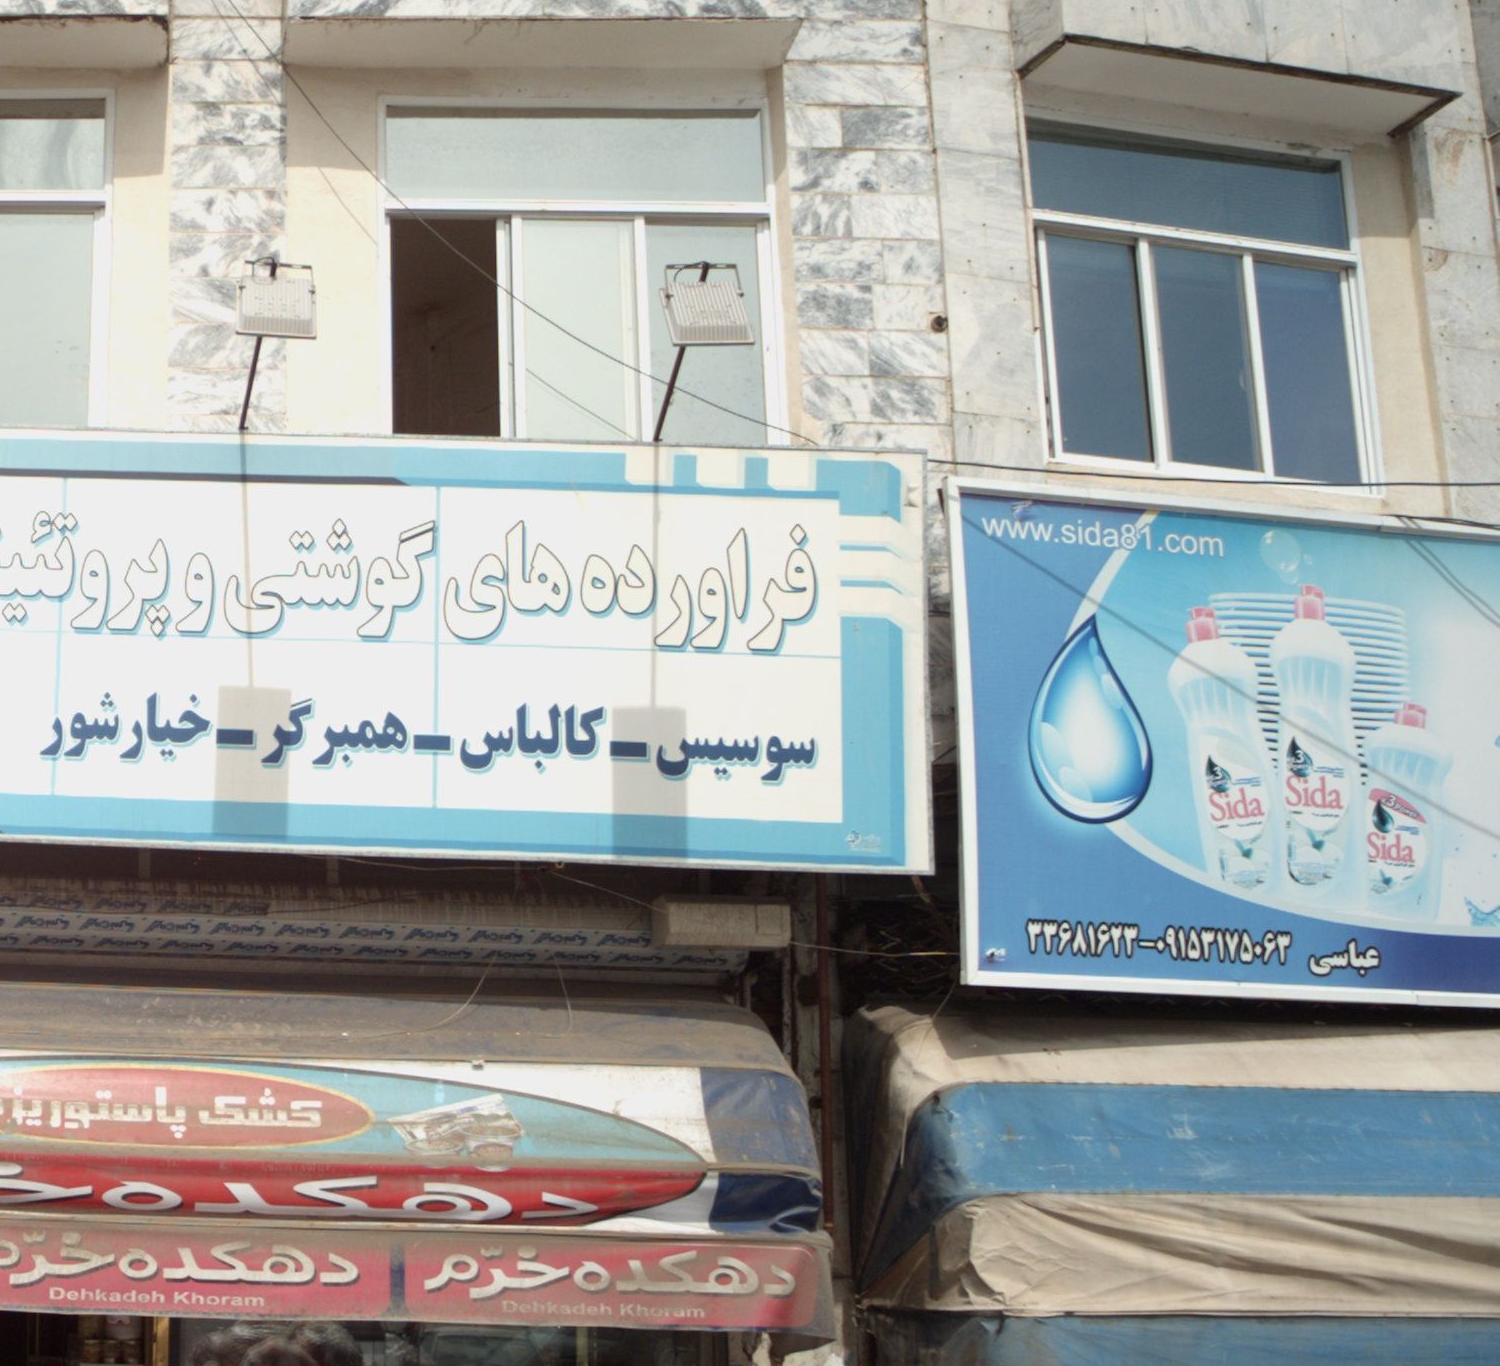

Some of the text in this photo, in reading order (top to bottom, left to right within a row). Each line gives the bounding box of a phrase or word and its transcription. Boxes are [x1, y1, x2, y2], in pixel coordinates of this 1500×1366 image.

[982, 518, 1224, 557] www.sida81.com
[176, 552, 216, 633] و
[223, 519, 437, 639] گوشتی
[260, 699, 409, 767] همبرگر
[459, 702, 606, 772] کالباس
[656, 736, 817, 782] سوسیس
[1208, 787, 1266, 822] Sida
[1285, 775, 1345, 812] Sida
[1367, 832, 1416, 863] Sida
[1308, 939, 1381, 978] عباسی
[198, 1086, 323, 1129] کشک
[102, 1174, 599, 1223] دهکده
[119, 1241, 360, 1284] دهکده
[573, 1250, 797, 1296] دهکده
[48, 1286, 265, 1307] Dehkadeh Khoram
[502, 1300, 706, 1319] Dehkadeh Khoram
